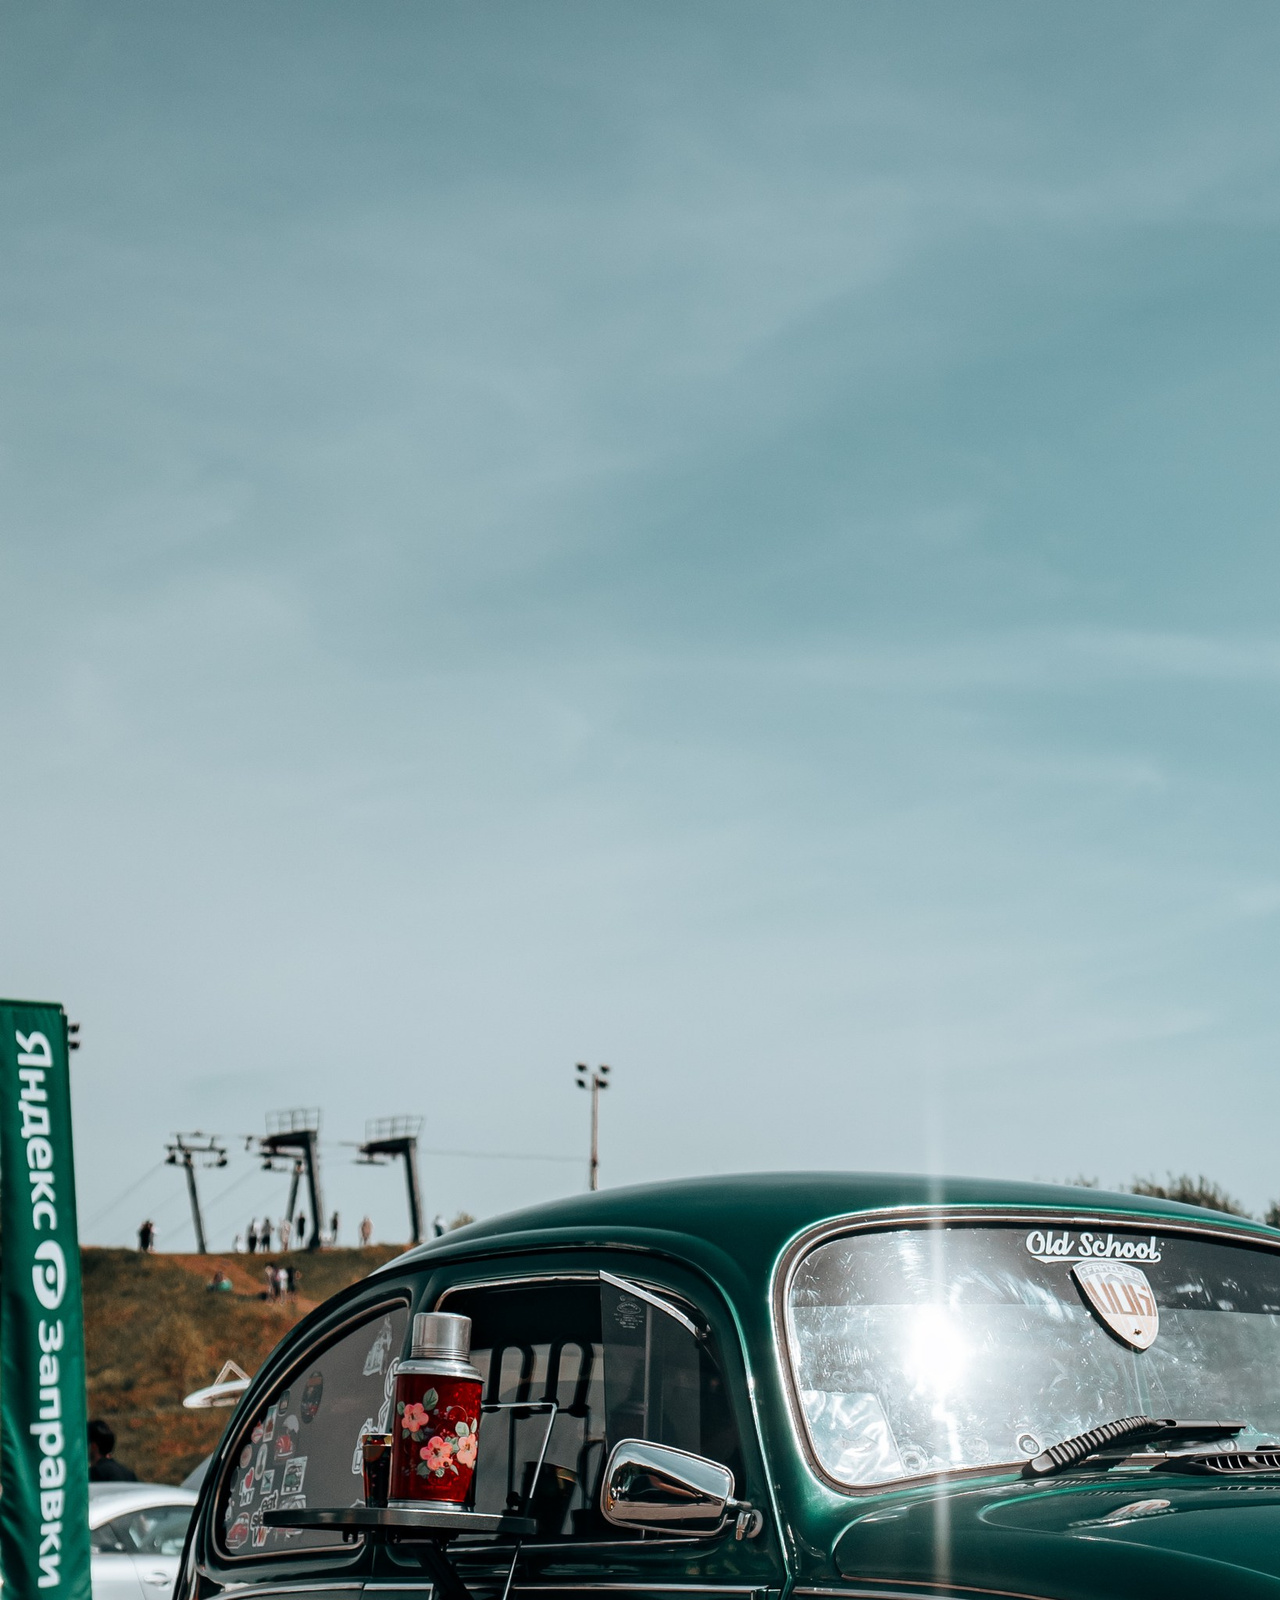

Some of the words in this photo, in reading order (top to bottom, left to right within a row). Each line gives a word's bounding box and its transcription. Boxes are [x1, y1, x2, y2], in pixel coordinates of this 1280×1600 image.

[15, 1029, 58, 1231] Яндекс
[1026, 1230, 1075, 1256] Old
[1078, 1232, 1161, 1262] School
[29, 1319, 67, 1589] Заправки
